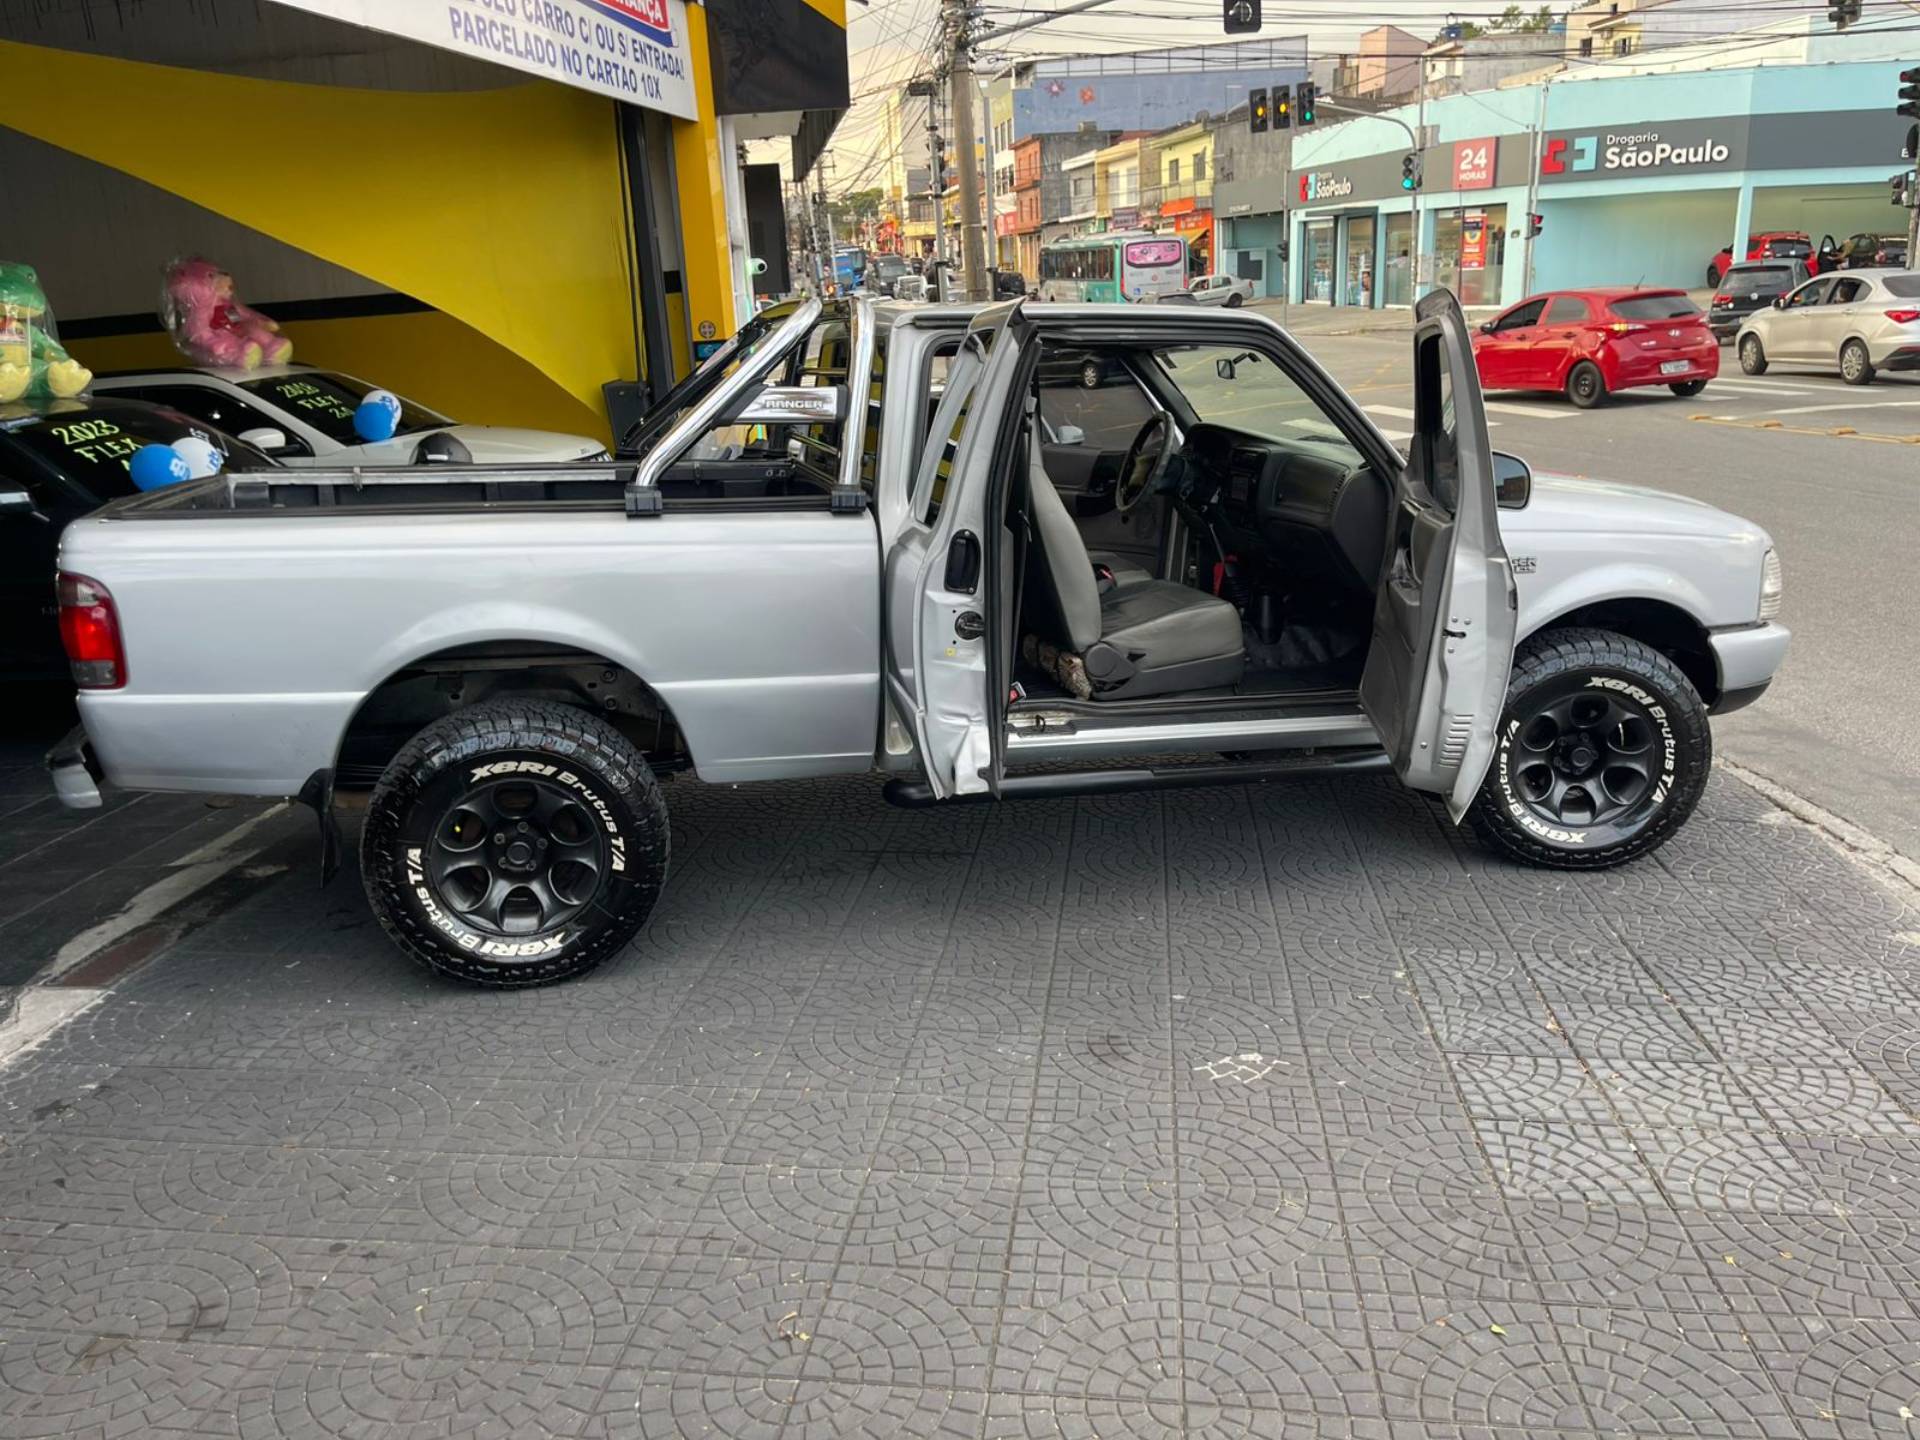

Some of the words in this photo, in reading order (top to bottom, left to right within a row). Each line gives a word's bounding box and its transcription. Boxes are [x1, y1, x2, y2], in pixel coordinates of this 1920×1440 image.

[449, 6, 557, 68] PARCELADO
[560, 43, 583, 76] NO
[641, 72, 663, 100] 10X
[522, 0, 575, 38] CARRO
[595, 23, 615, 53] OU
[631, 38, 685, 80] ENTRADA!
[1606, 131, 1659, 145] Drogaria
[1460, 147, 1488, 171] 24
[1459, 170, 1487, 181] HORAS
[765, 400, 823, 409] RANGER
[52, 420, 120, 445] 2023
[74, 438, 144, 463] FLEX
[1584, 676, 1656, 706] XBRI
[1501, 719, 1521, 749] T/A
[1648, 705, 1677, 772] Brutus
[1499, 751, 1525, 817] Brutus
[1651, 774, 1675, 803] T/A
[470, 761, 559, 783] XBRI
[556, 771, 618, 834] Brutus
[610, 836, 626, 872] T/A
[1520, 815, 1589, 843] XBRI
[406, 847, 424, 885] T/A
[416, 886, 481, 949] Brutus
[479, 931, 566, 957] XBRI
